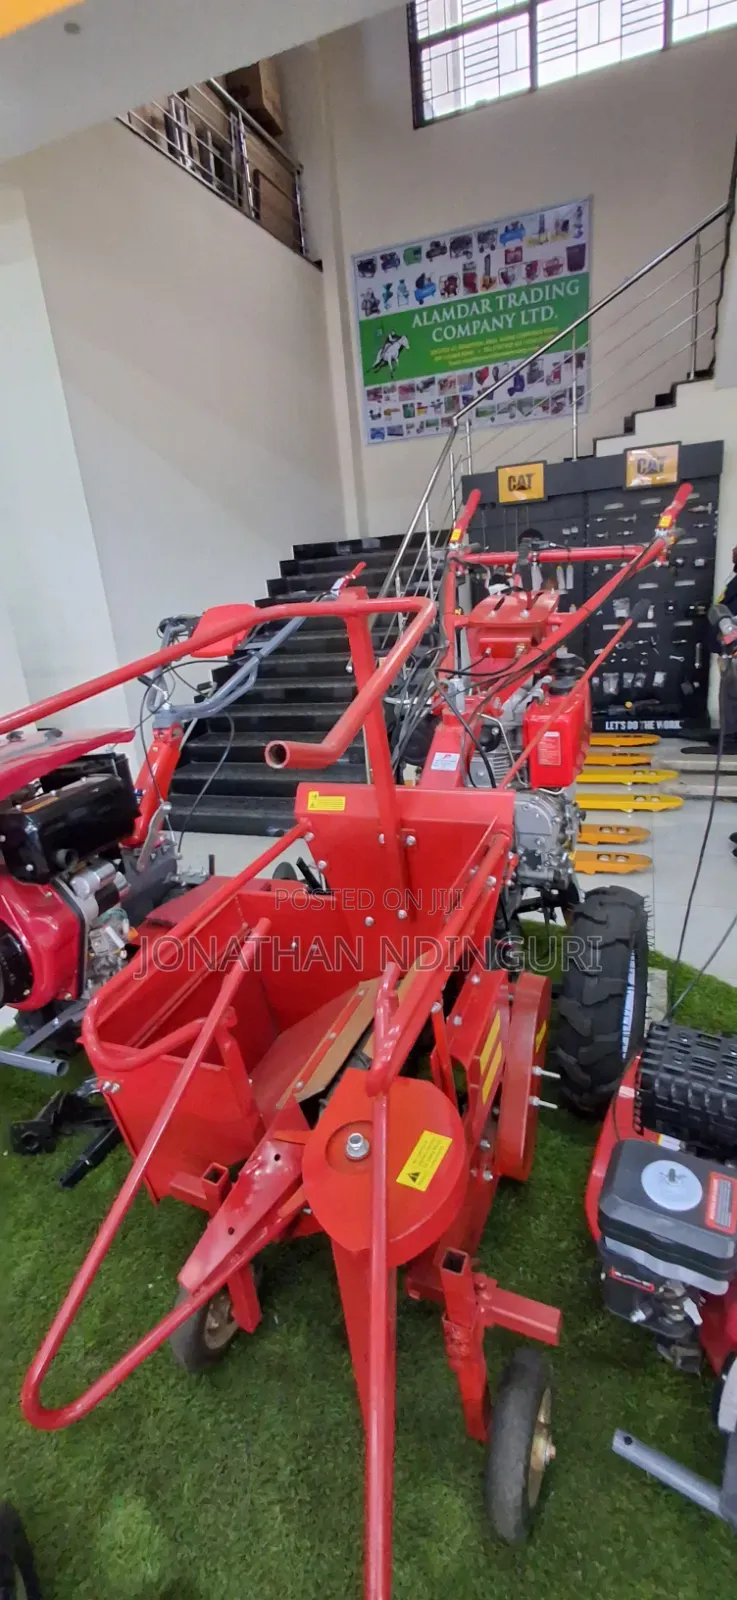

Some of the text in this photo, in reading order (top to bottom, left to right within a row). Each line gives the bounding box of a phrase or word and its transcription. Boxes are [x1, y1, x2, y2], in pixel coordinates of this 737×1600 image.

[411, 279, 580, 328] ALAMDAR TRADING
[431, 313, 516, 342] COMPANY
[520, 305, 558, 325] LTD.
[637, 456, 666, 475] CAT
[507, 474, 533, 492] CAT
[605, 721, 626, 730] LET'S
[627, 721, 638, 730] DO
[639, 720, 655, 730] THE
